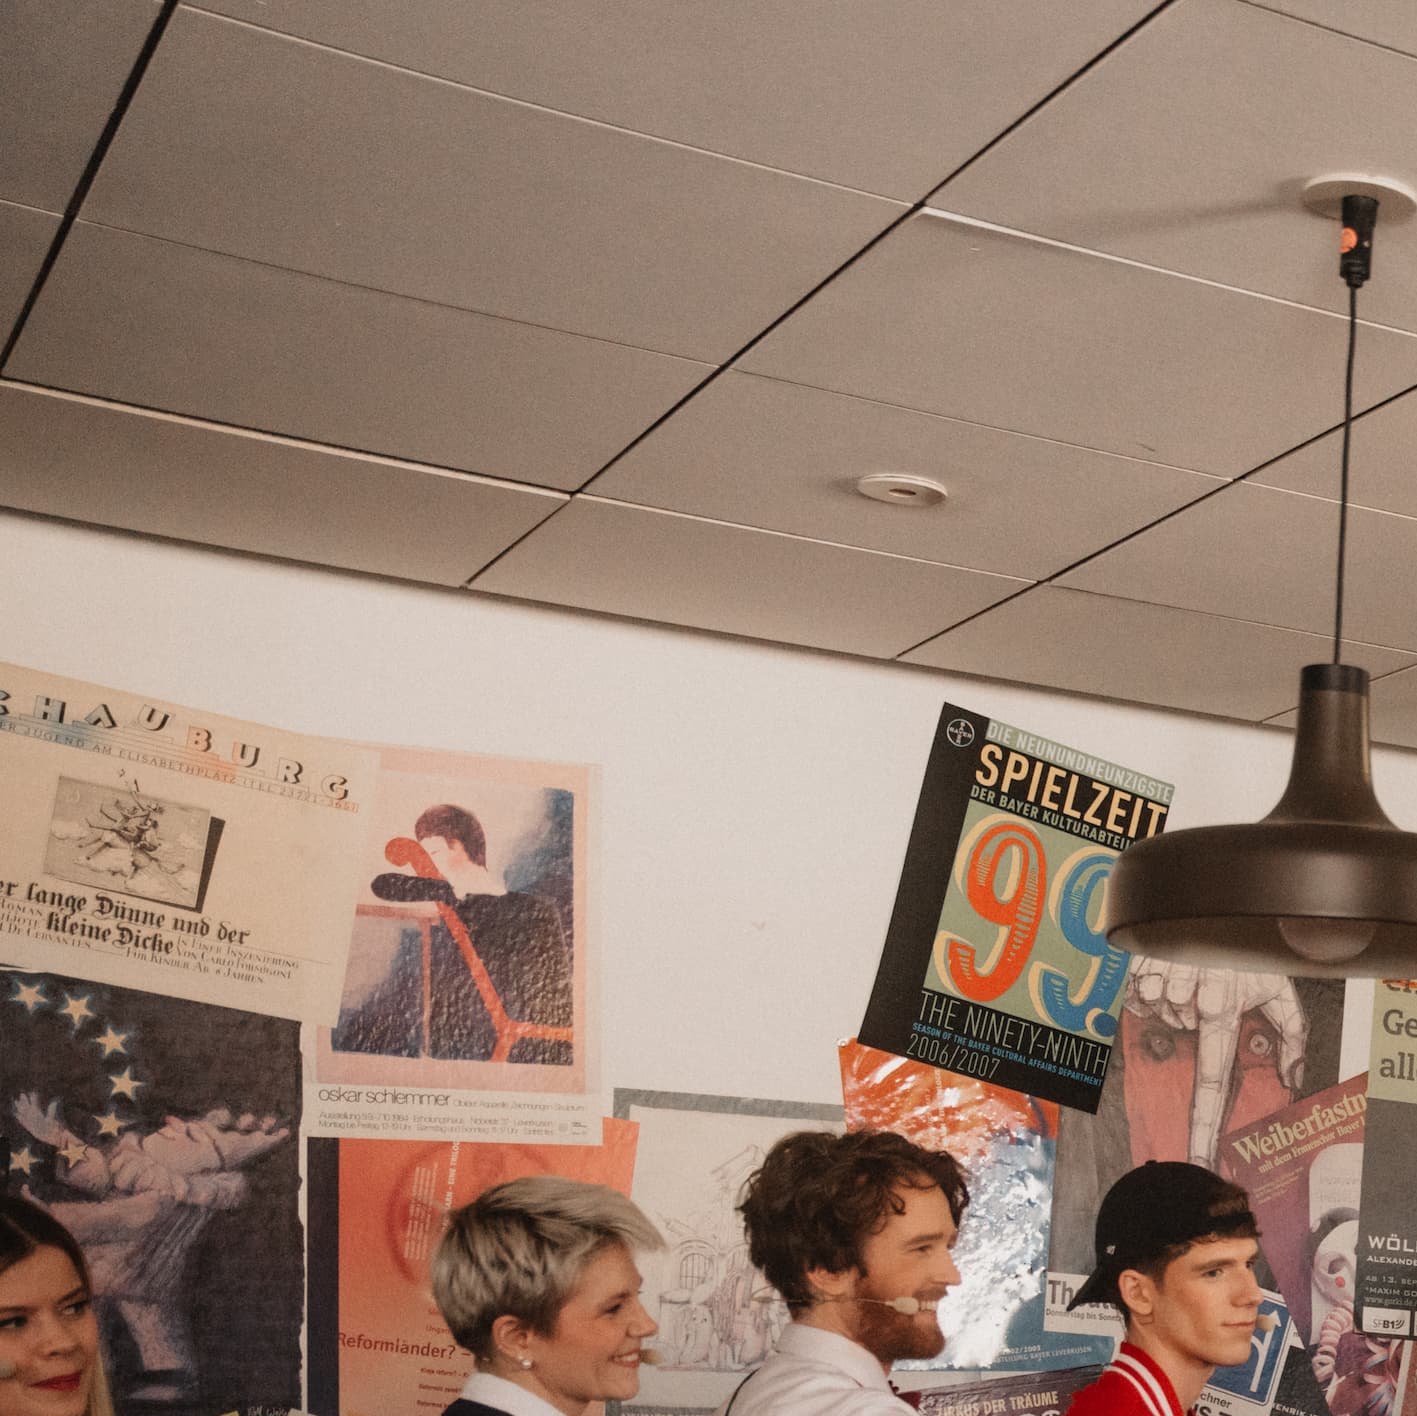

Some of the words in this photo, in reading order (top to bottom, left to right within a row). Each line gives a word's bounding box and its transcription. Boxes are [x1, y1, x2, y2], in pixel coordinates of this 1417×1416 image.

[25, 726, 86, 749] JUGEND
[93, 743, 113, 755] AM
[986, 721, 1010, 743] DIE
[1015, 731, 1175, 802] NEUNUNDNEUNZIGSTE
[970, 784, 997, 803] DER
[999, 792, 1040, 822] BAYER
[975, 743, 1169, 838] SPIELZEIT
[26, 882, 87, 917] lange
[92, 891, 166, 929] Dünne
[172, 915, 210, 937] und
[216, 919, 250, 945] der
[46, 911, 112, 943] kleine
[112, 922, 175, 956] Dicke
[906, 1032, 1001, 1080] 2006/2007
[912, 1022, 942, 1039] SEASON
[942, 1031, 953, 1042] OF
[953, 1033, 967, 1047] THE
[967, 1038, 992, 1053] BAYER
[992, 1043, 1027, 1064] CULTURAL
[1027, 1056, 1058, 1074] AFFAIRS
[1058, 1065, 1103, 1087] DEPARTMENT
[918, 990, 962, 1031] THE
[962, 1006, 1110, 1077] NINETY-NINTH
[319, 1086, 363, 1103] oskar
[366, 1088, 450, 1106] schlemmer
[1232, 1093, 1368, 1165] Weiberfastn
[1086, 1312, 1098, 1321] bis
[338, 1332, 456, 1360] Reformländer?
[983, 1398, 1007, 1416] DER
[1010, 1391, 1060, 1411] TRÄUME
